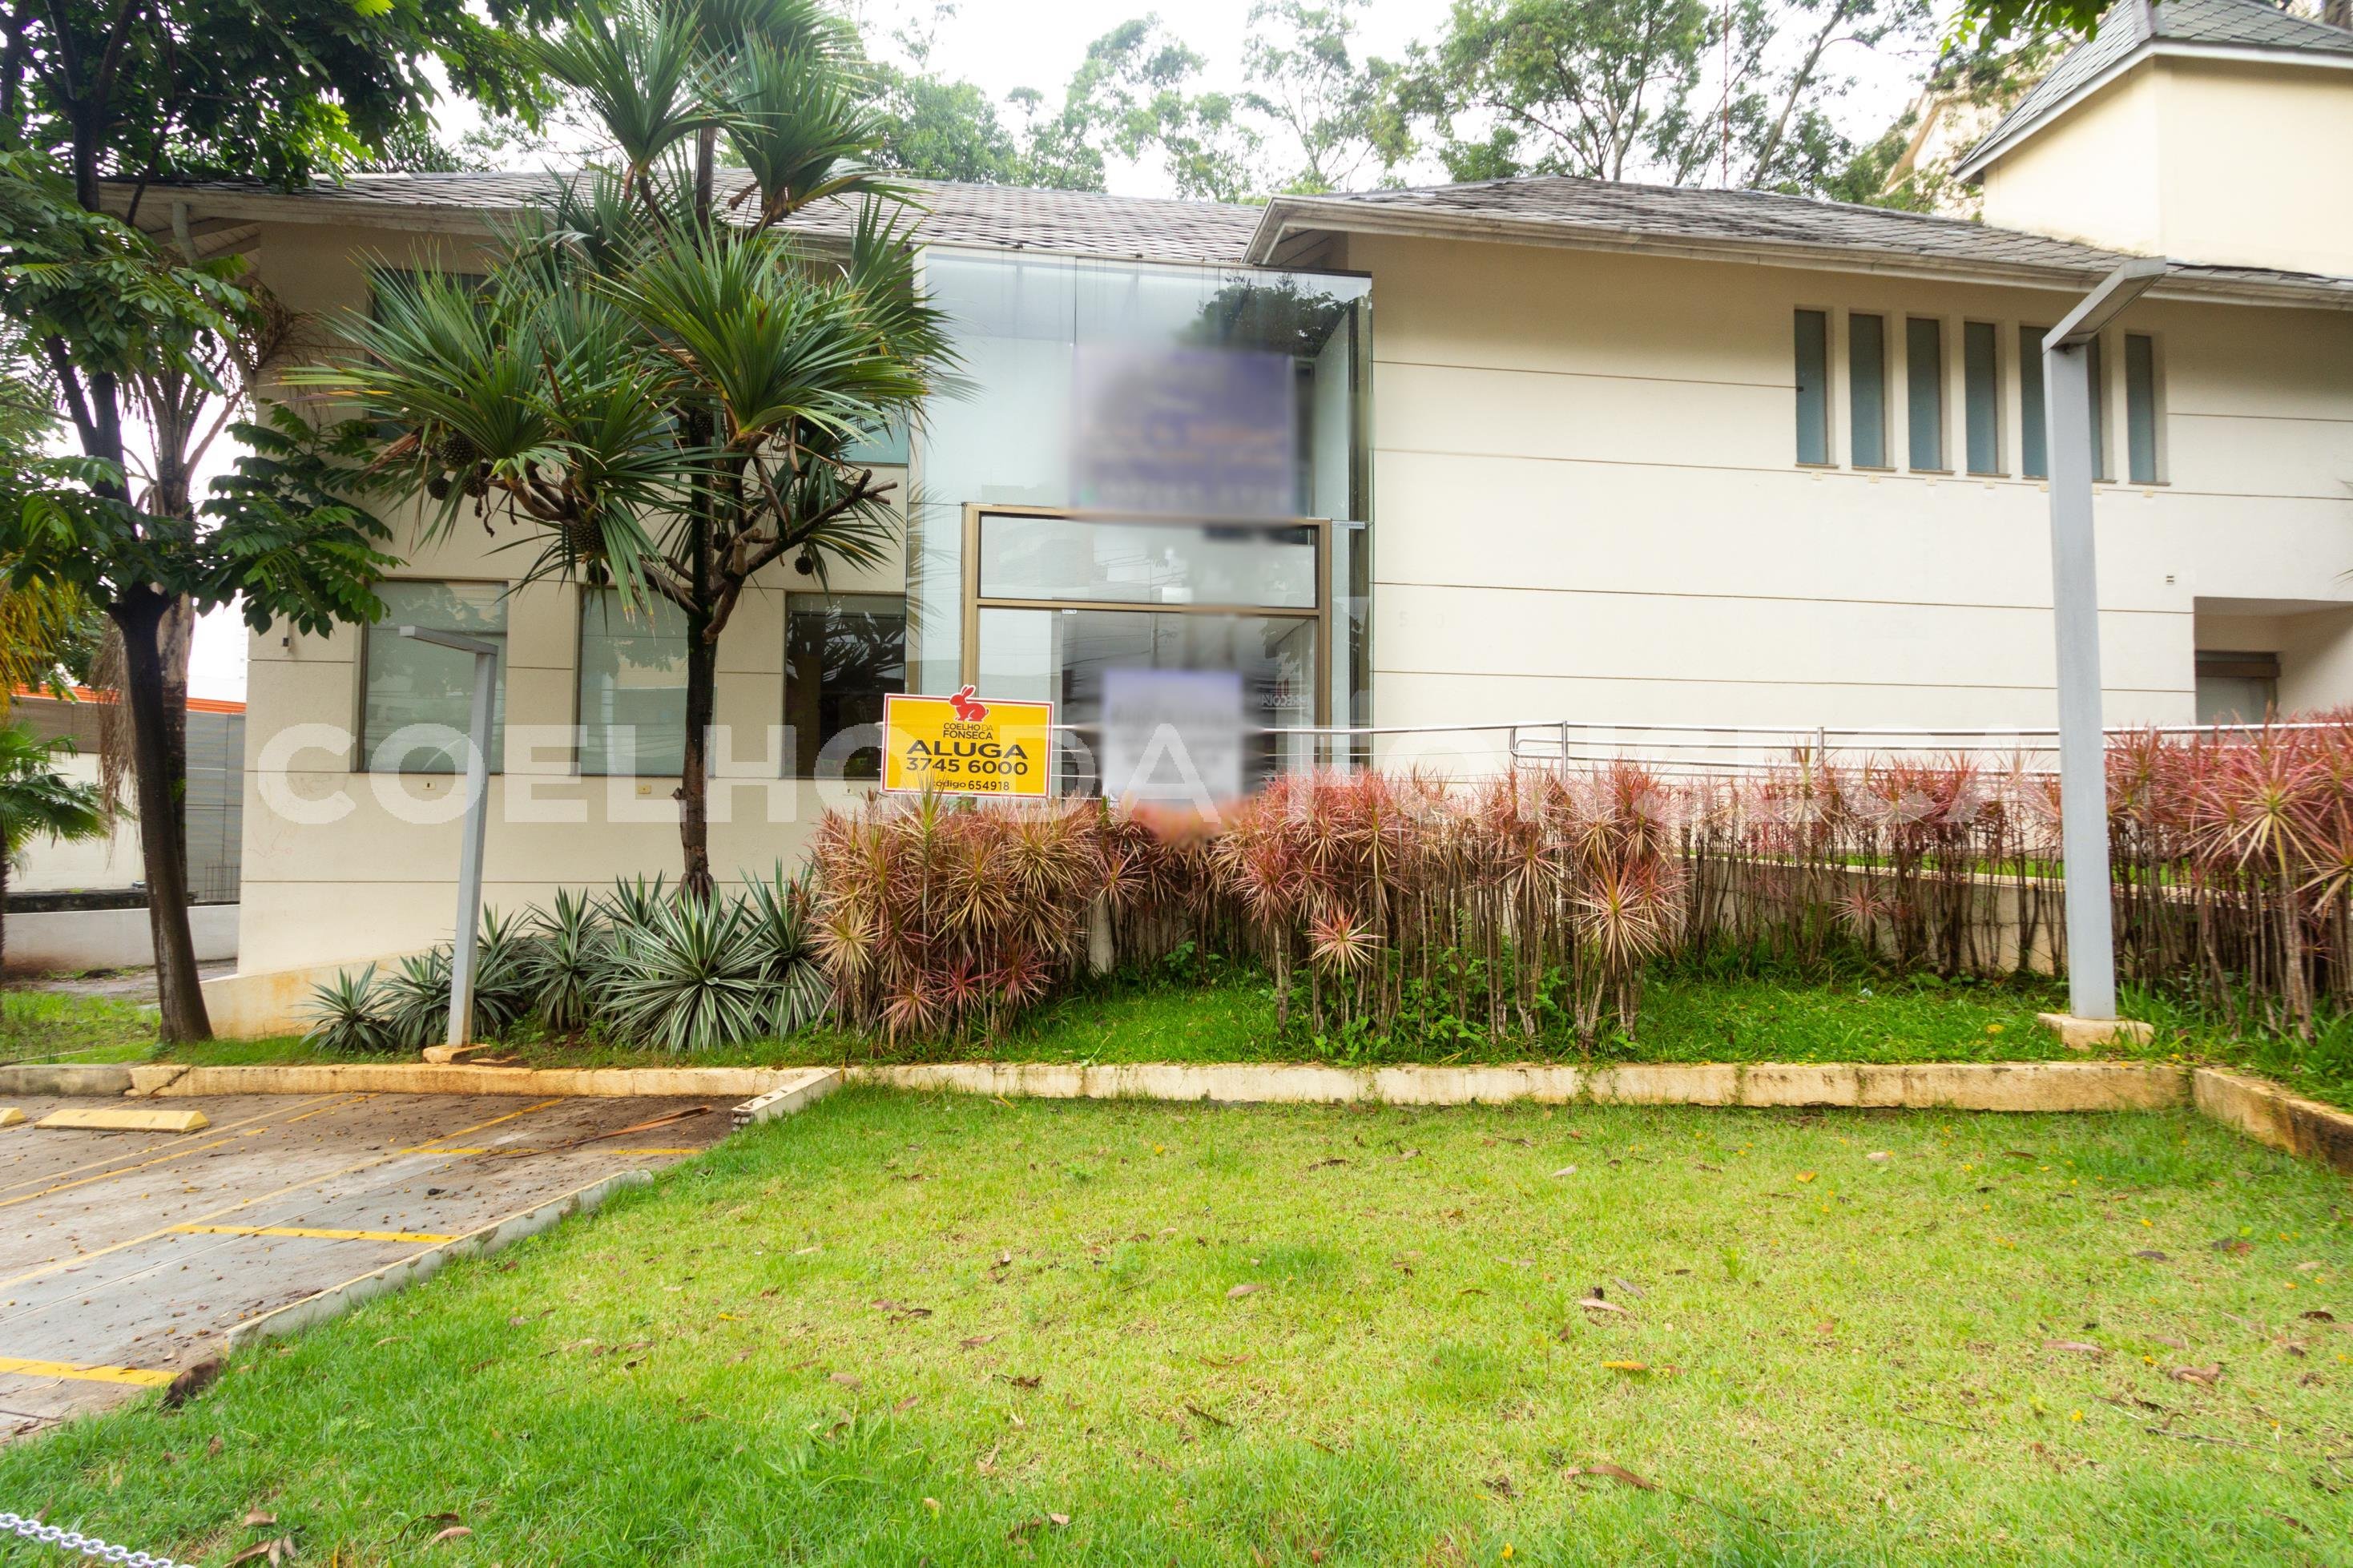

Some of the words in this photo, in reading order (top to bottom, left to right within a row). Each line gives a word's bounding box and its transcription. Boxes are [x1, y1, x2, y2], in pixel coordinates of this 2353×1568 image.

[943, 723, 981, 731] COELHO
[942, 730, 993, 740] FONSECA
[906, 740, 1029, 760] ALUGA
[905, 756, 961, 773] 3745
[968, 760, 1029, 776] 6000
[968, 780, 1009, 791] 654918
